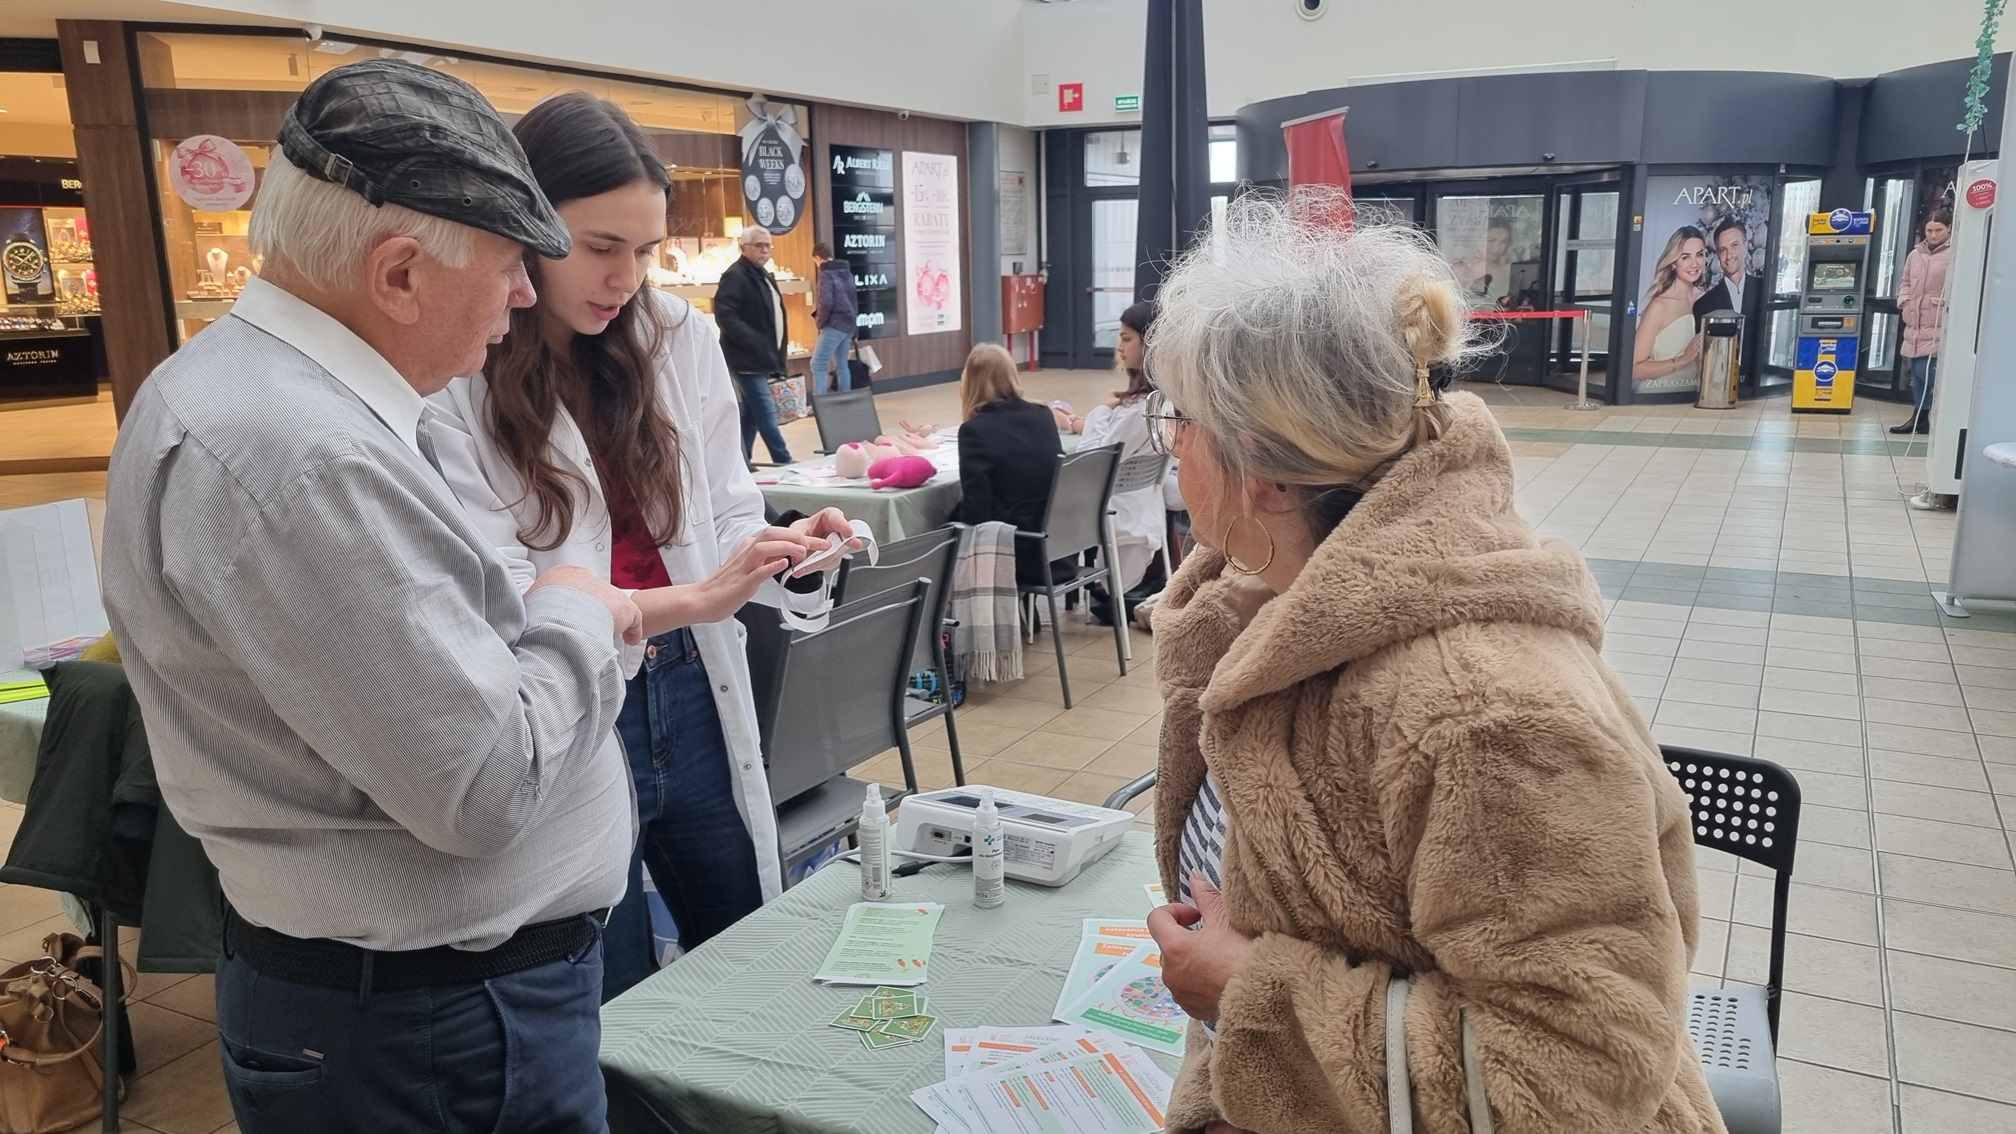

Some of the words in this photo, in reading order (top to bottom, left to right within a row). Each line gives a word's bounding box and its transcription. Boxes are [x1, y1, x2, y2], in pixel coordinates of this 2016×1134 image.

[759, 146, 783, 157] BLACK
[758, 159, 785, 170] WEEKS
[846, 155, 871, 169] ALBERT
[61, 179, 82, 189] BER
[1973, 182, 1993, 192] 100%
[1672, 186, 1754, 208] APART.pl
[843, 200, 884, 214] BERGSTERN
[913, 212, 950, 227] RABATY
[844, 234, 886, 248] AZTORIN
[854, 273, 888, 286] LIXA
[856, 312, 884, 328] mpm
[7, 350, 59, 361] AZTORIN
[1645, 378, 1699, 389] ZAPRASZAM
